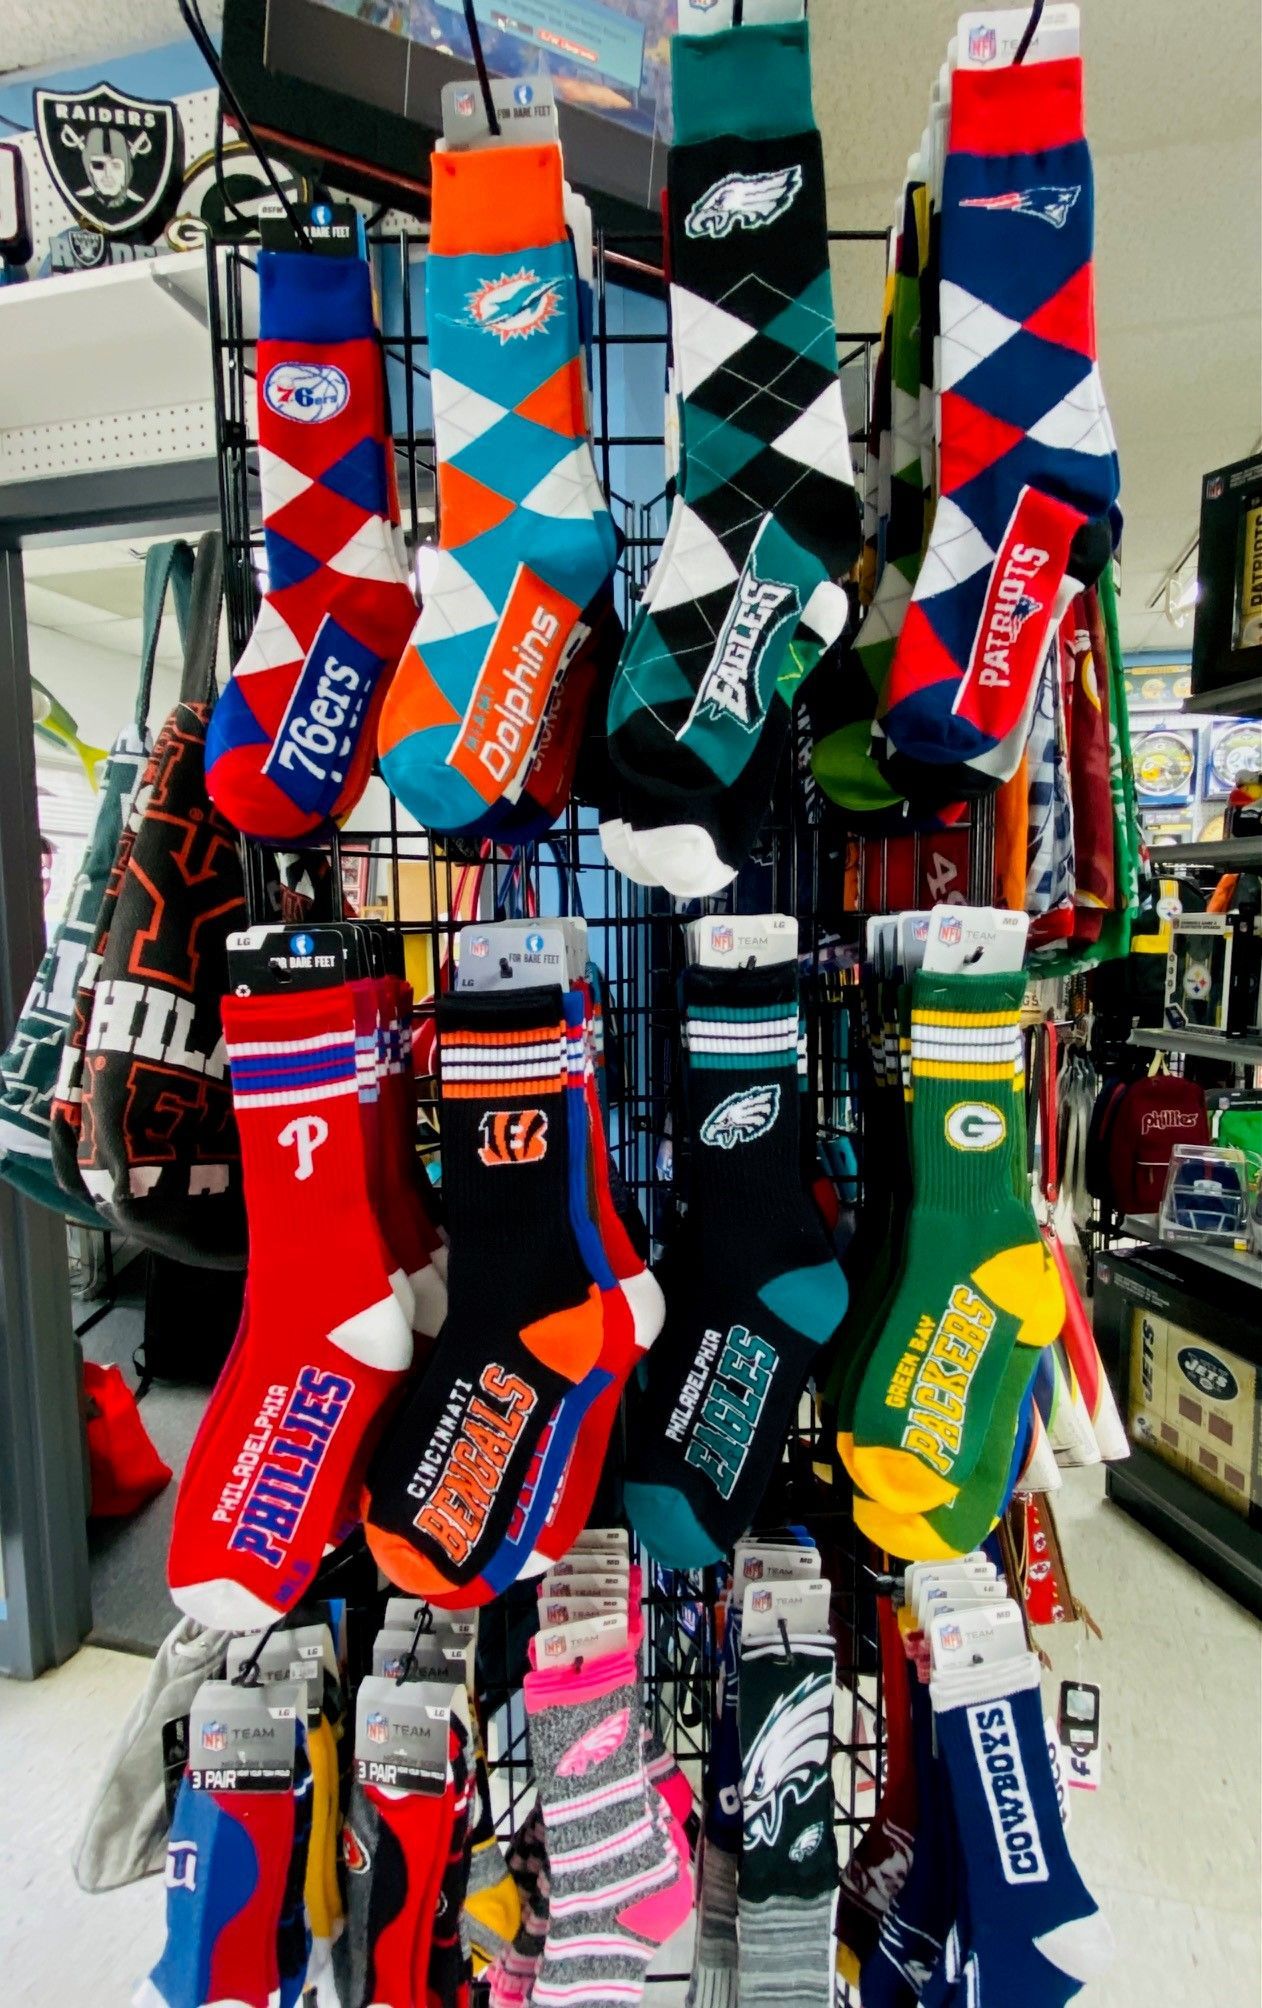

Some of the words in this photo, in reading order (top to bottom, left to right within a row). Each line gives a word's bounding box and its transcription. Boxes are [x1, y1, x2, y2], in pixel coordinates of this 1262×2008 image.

[1001, 38, 1039, 51] TEM
[54, 103, 156, 128] RAIDERS
[332, 226, 350, 238] FEET
[978, 543, 1049, 688] PATRIOTS
[703, 577, 797, 723] EAGLES
[478, 605, 560, 783] Dolphins
[278, 655, 361, 783] 76ers
[237, 937, 251, 946] LG
[738, 936, 768, 945] TEAM
[966, 930, 997, 941] TEAM
[289, 957, 313, 969] BARE
[314, 955, 336, 968] FEET
[524, 953, 541, 964] BARE
[543, 954, 560, 965] FEET
[461, 978, 475, 987] LG
[277, 1115, 329, 1181] P
[884, 1347, 921, 1410] GREEN
[910, 1314, 938, 1352] BAY
[900, 1283, 998, 1476] PACKERS
[1183, 1359, 1229, 1389] JETS
[664, 1328, 723, 1443] PHILADELPHIA
[684, 1324, 780, 1501] EAGLES
[406, 1377, 474, 1501] CINCINNATI
[211, 1383, 290, 1524] PHILADELPHIA
[226, 1364, 357, 1569] PHILLIES
[412, 1362, 539, 1567] BENGALS
[767, 1566, 794, 1577] TEAM
[776, 1596, 804, 1605] TEAM
[965, 1629, 995, 1640] TEAM
[307, 1647, 319, 1656] LG
[267, 1670, 291, 1681] TEA
[278, 1708, 291, 1717] LG
[434, 1709, 446, 1717] LG
[232, 1727, 275, 1739] TEAM
[393, 1723, 432, 1738] TEAM
[192, 1771, 202, 1789] 3
[205, 1770, 237, 1789] PAIR
[358, 1761, 367, 1779] 3
[369, 1762, 398, 1784] PAIR
[975, 1708, 1040, 1876] COWBOYS
